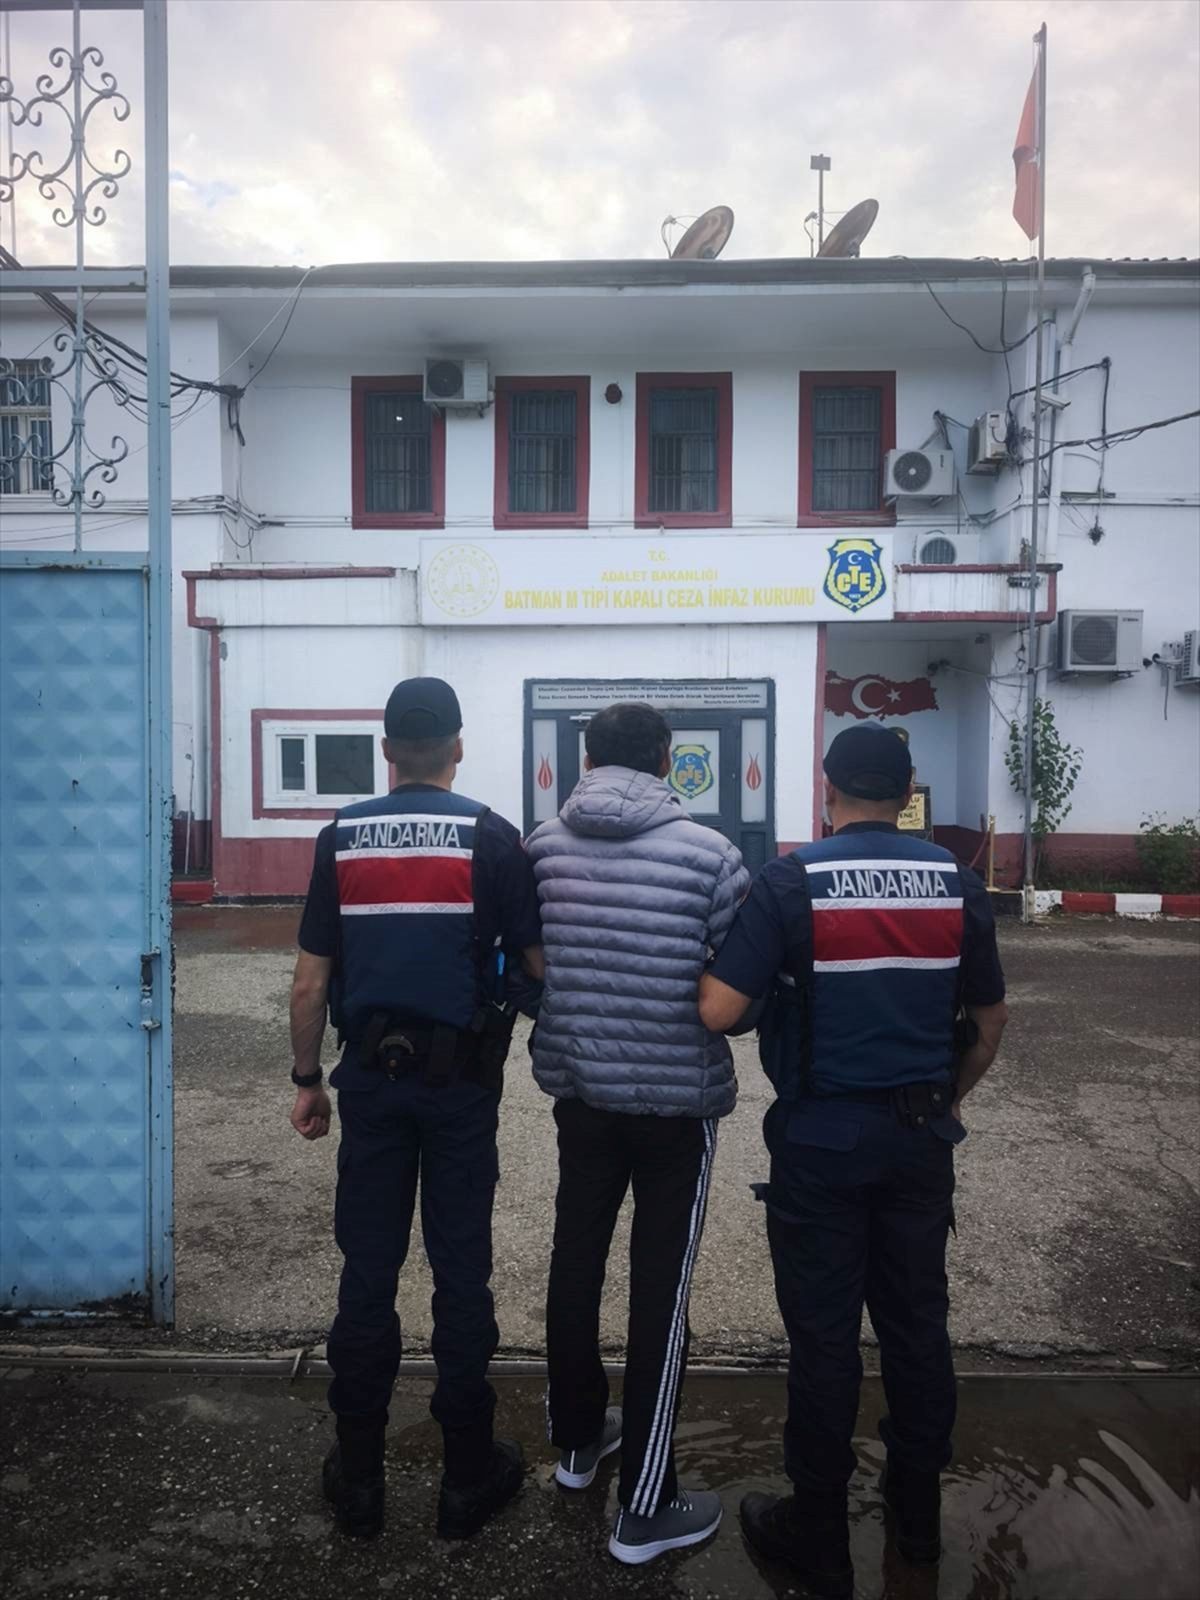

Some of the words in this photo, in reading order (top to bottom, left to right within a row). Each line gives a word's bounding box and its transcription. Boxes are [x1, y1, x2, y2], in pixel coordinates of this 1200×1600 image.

[601, 570, 648, 582] ADALET
[651, 567, 718, 582] BAKANLIĞI
[503, 589, 562, 609] BATMAN
[565, 589, 578, 609] M
[582, 586, 609, 609] TİPİ
[613, 588, 663, 609] KAPALI
[666, 587, 705, 608] CEZA
[707, 584, 749, 607] İNFAZ
[752, 587, 816, 607] KURUMU
[348, 822, 461, 848] JANDARMA
[827, 870, 949, 898] JANDARMA
